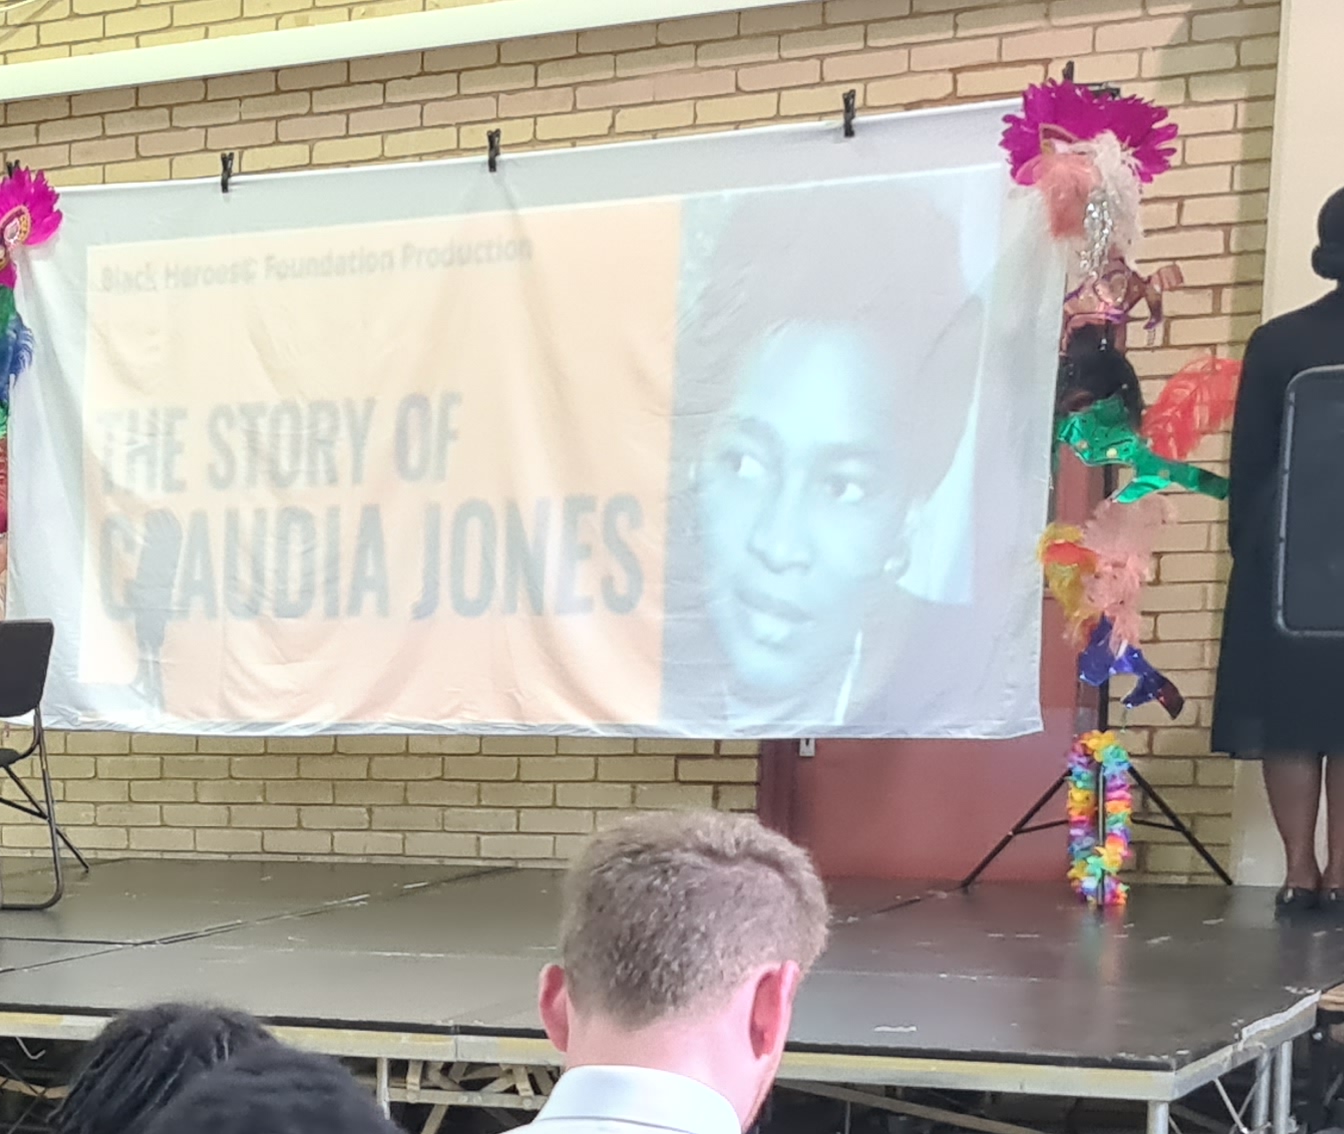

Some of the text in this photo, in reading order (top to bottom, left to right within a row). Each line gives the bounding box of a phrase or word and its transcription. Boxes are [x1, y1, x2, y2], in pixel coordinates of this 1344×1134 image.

[100, 261, 158, 293] Black
[264, 246, 395, 281] Foundation
[401, 235, 534, 270] Production
[97, 391, 463, 494] THE STORY OF
[99, 492, 644, 620] CAUDIA JONES
